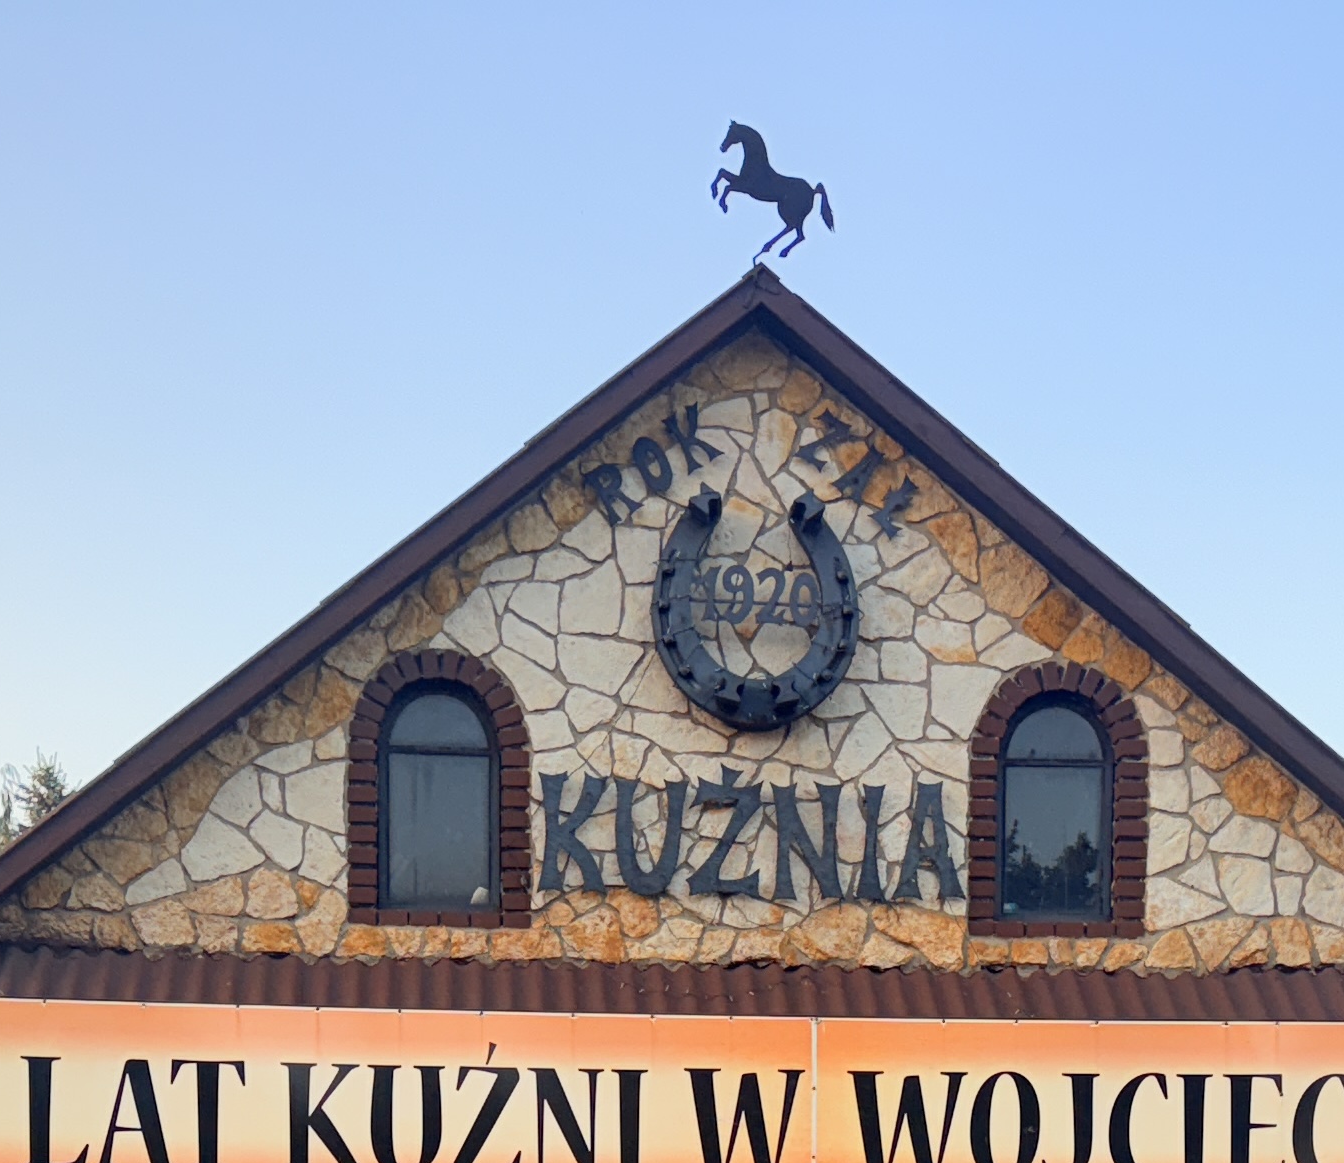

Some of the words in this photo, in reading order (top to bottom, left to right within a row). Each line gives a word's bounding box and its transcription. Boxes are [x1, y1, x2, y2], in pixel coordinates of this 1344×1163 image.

[581, 401, 724, 526] ROK
[692, 564, 821, 627] 1920
[537, 764, 967, 902] KUŹNIA
